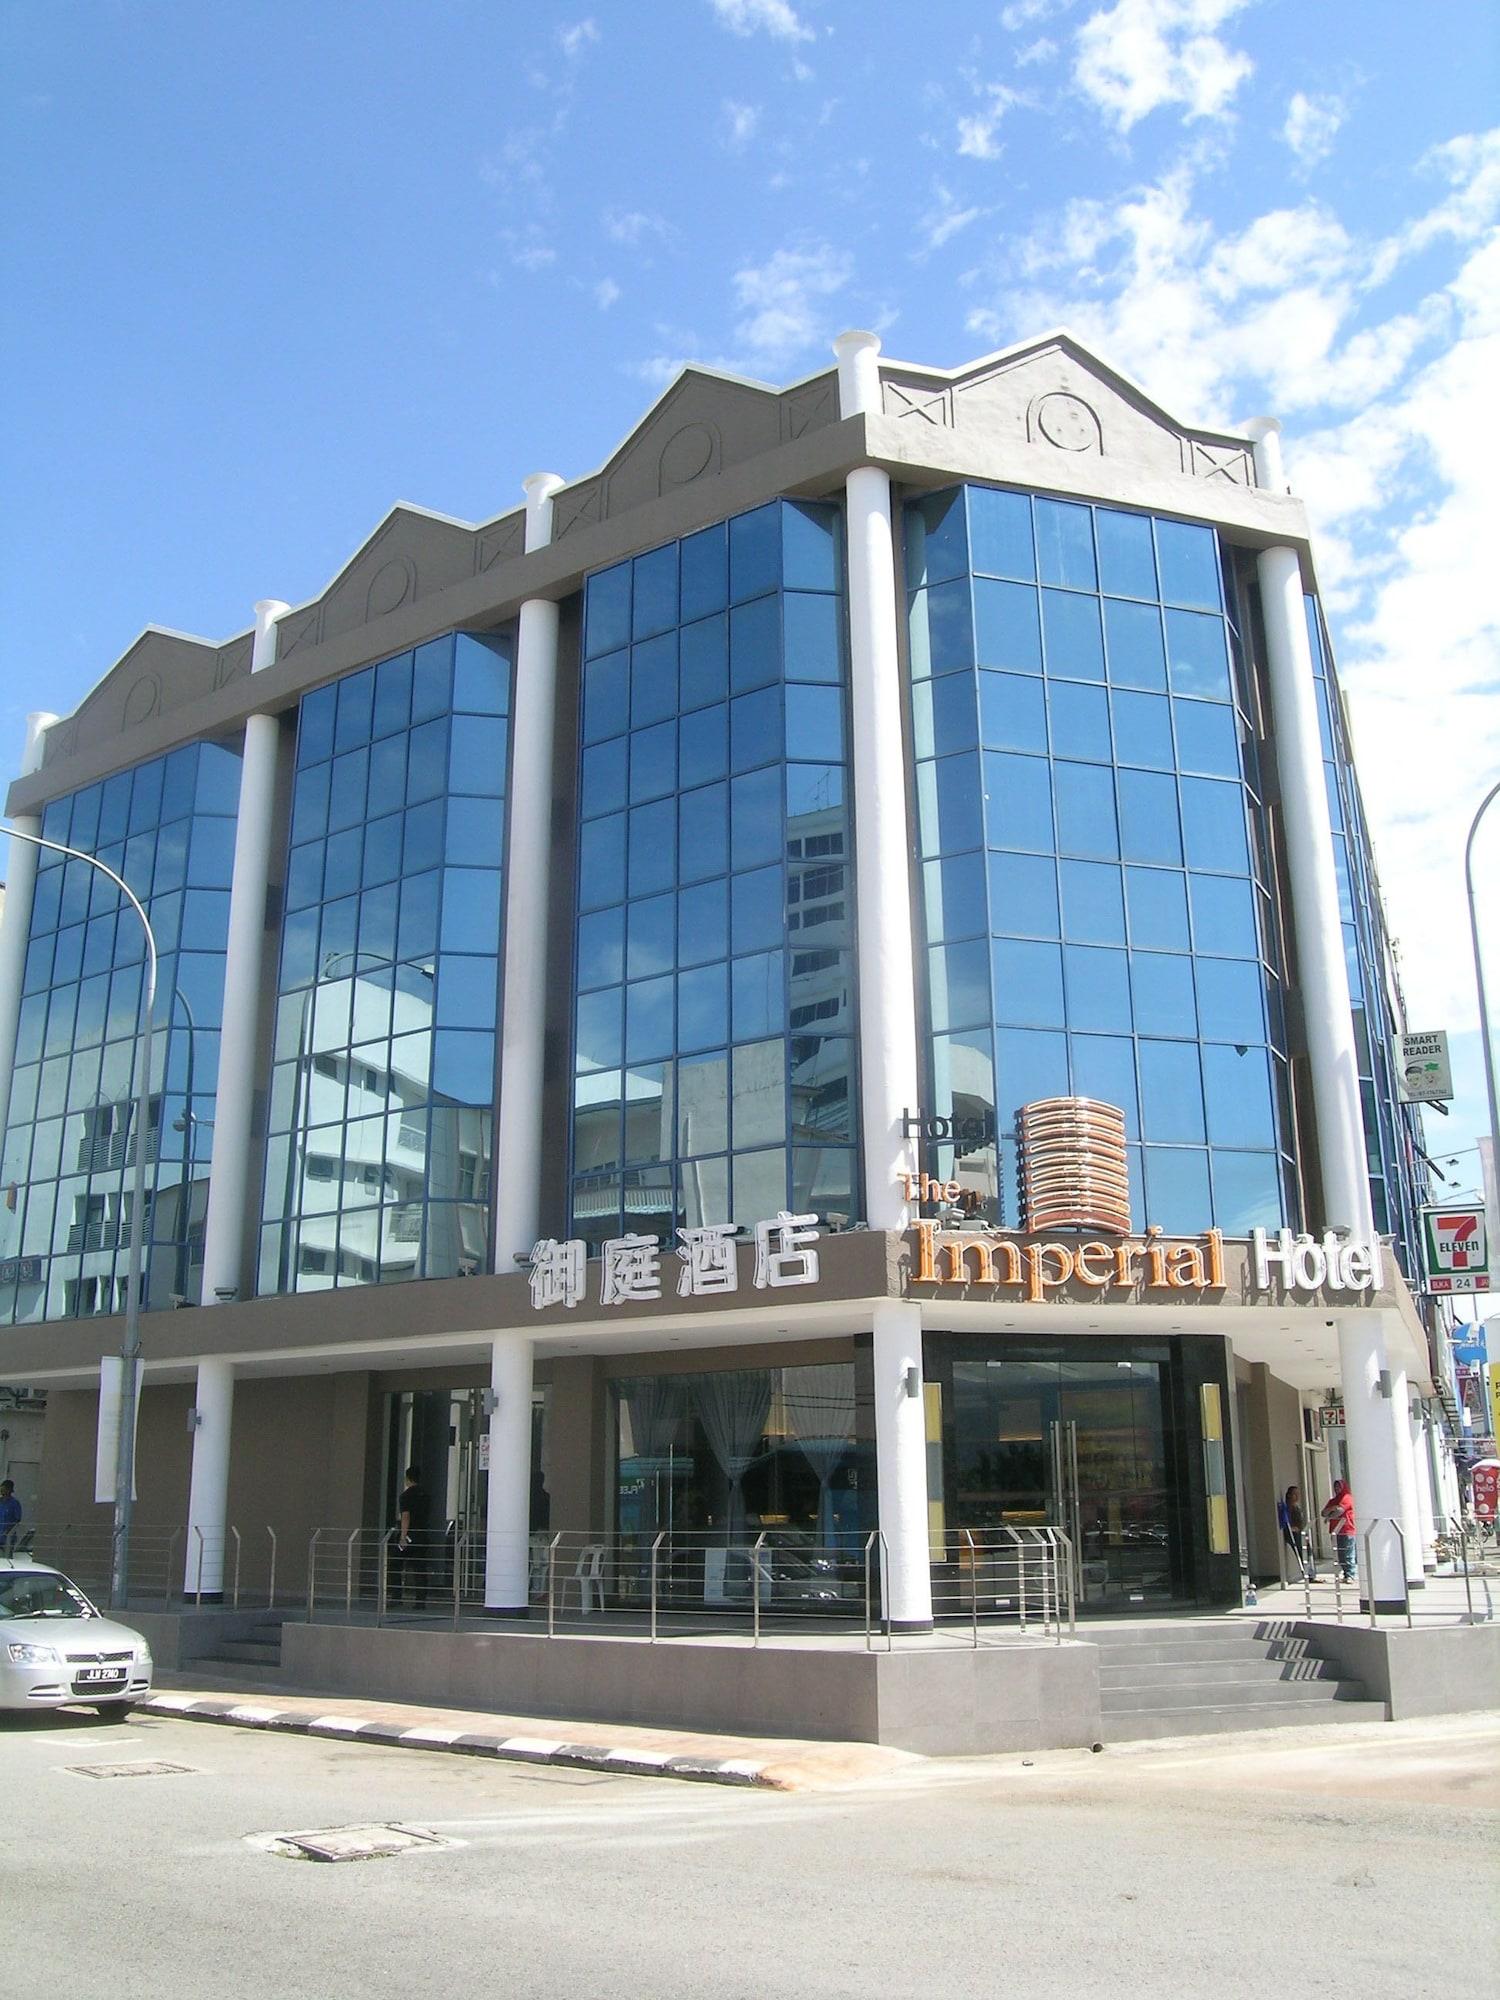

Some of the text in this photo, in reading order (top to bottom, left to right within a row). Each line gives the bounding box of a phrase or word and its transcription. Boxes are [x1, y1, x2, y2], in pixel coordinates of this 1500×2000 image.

[1403, 1045, 1442, 1056] READER
[1404, 1035, 1438, 1046] SMART
[897, 1173, 961, 1204] The
[1437, 1216, 1478, 1268] 7
[528, 1210, 821, 1310] 御庭酒店
[912, 1219, 1385, 1303] Imperial Hotel
[1456, 1278, 1471, 1289] 24
